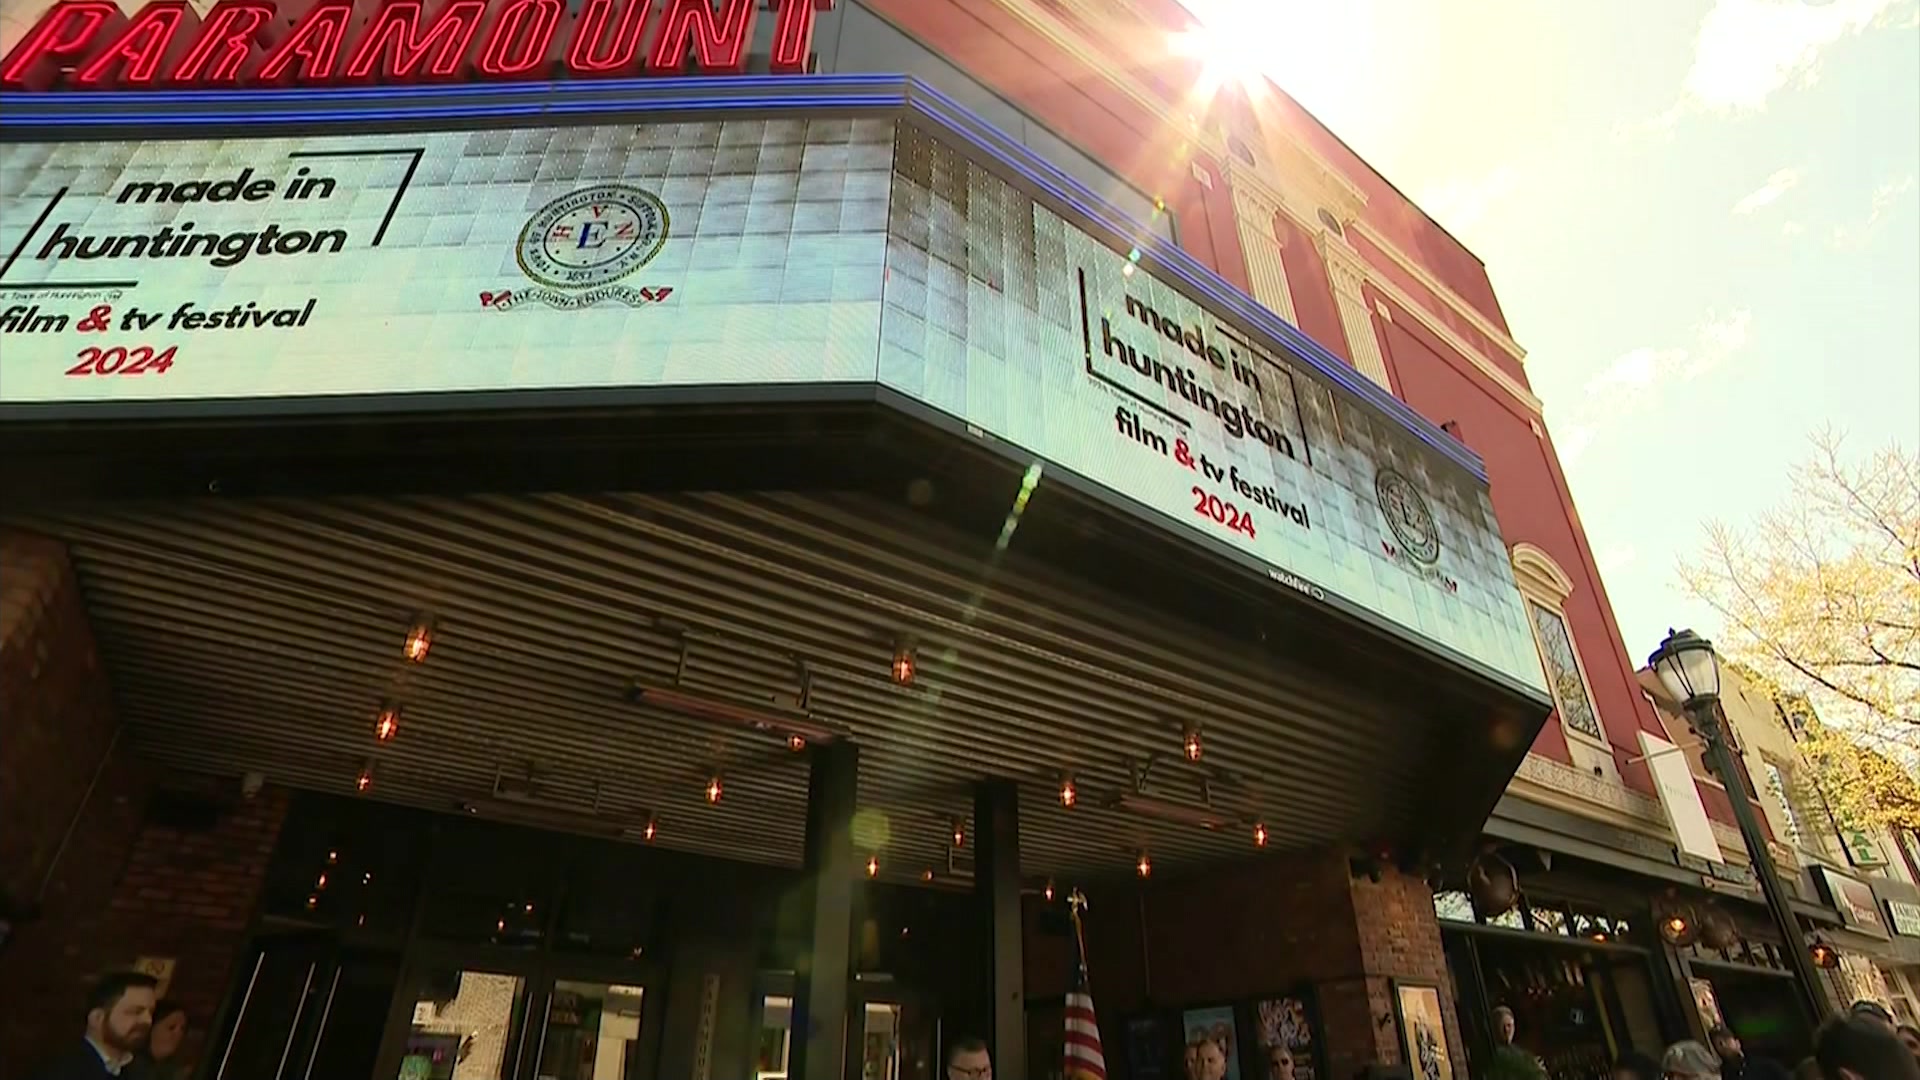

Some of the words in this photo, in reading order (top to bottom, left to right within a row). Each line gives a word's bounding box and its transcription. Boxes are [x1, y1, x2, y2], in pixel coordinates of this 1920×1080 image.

[0, 0, 834, 89] PARAMOUNT
[116, 169, 275, 204] made
[284, 168, 336, 200] in
[36, 222, 347, 268] huntington
[576, 221, 610, 249] E
[0, 305, 69, 334] film
[77, 305, 112, 332] &
[120, 307, 162, 332] tv
[167, 299, 317, 331] festival
[66, 346, 178, 377] 2024
[1126, 293, 1226, 372] made
[1231, 351, 1262, 393] in
[1101, 316, 1295, 460] huntington
[1115, 405, 1168, 456] film
[1174, 438, 1196, 472] &
[1199, 456, 1225, 482] tv
[1230, 465, 1310, 530] festival
[1191, 486, 1257, 540] 2024
